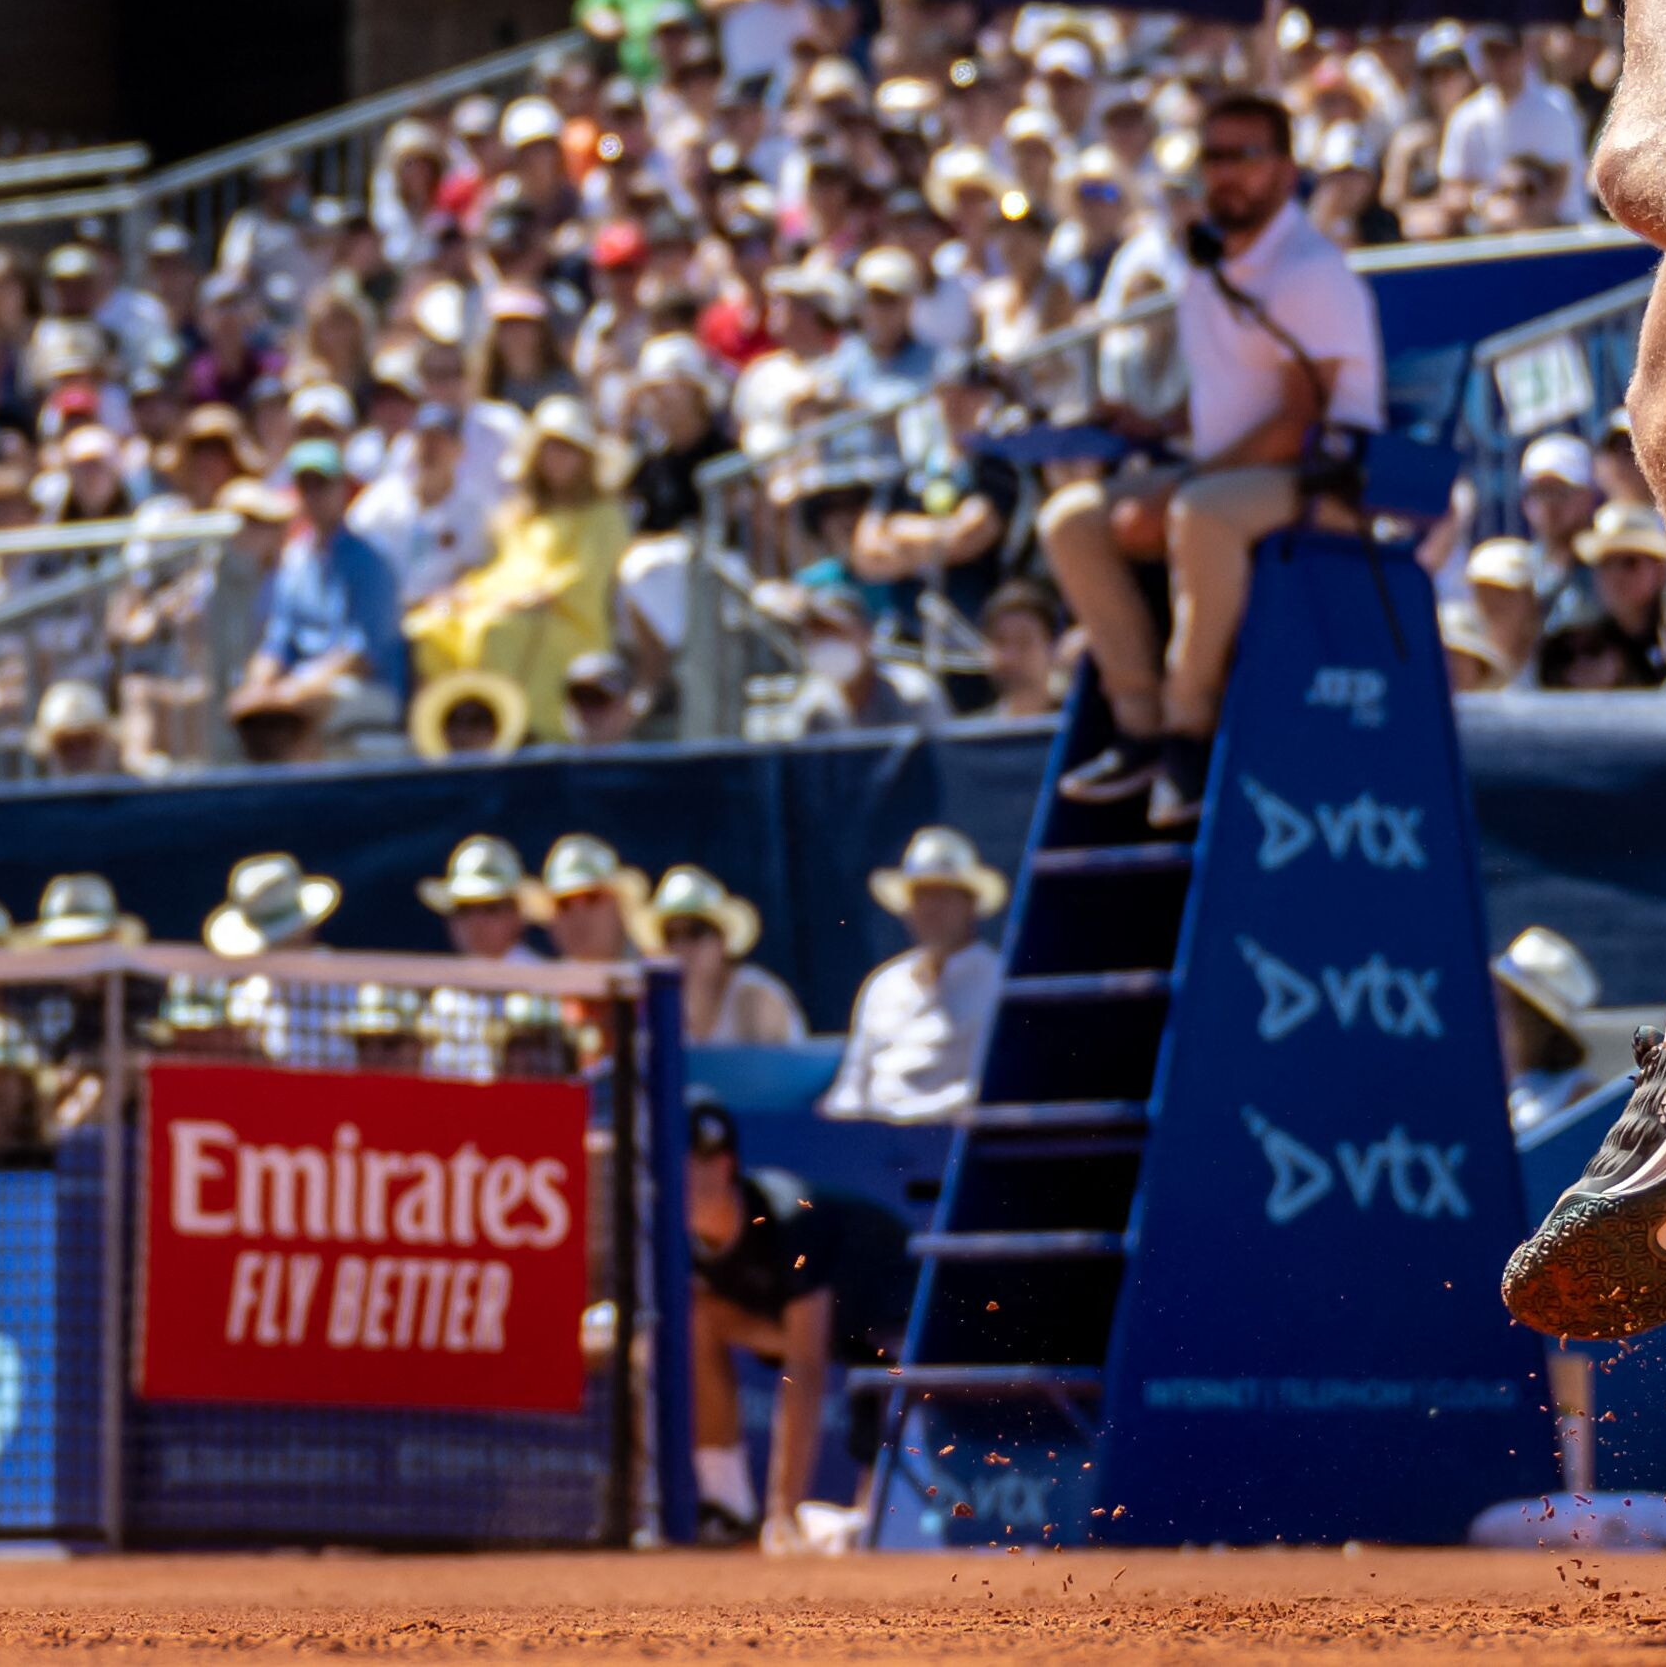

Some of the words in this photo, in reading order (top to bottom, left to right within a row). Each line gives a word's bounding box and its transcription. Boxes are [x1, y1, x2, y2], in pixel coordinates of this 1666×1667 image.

[169, 1117, 571, 1249] Emirates
[225, 1249, 323, 1347] FLY
[326, 1253, 511, 1354] BETTER
